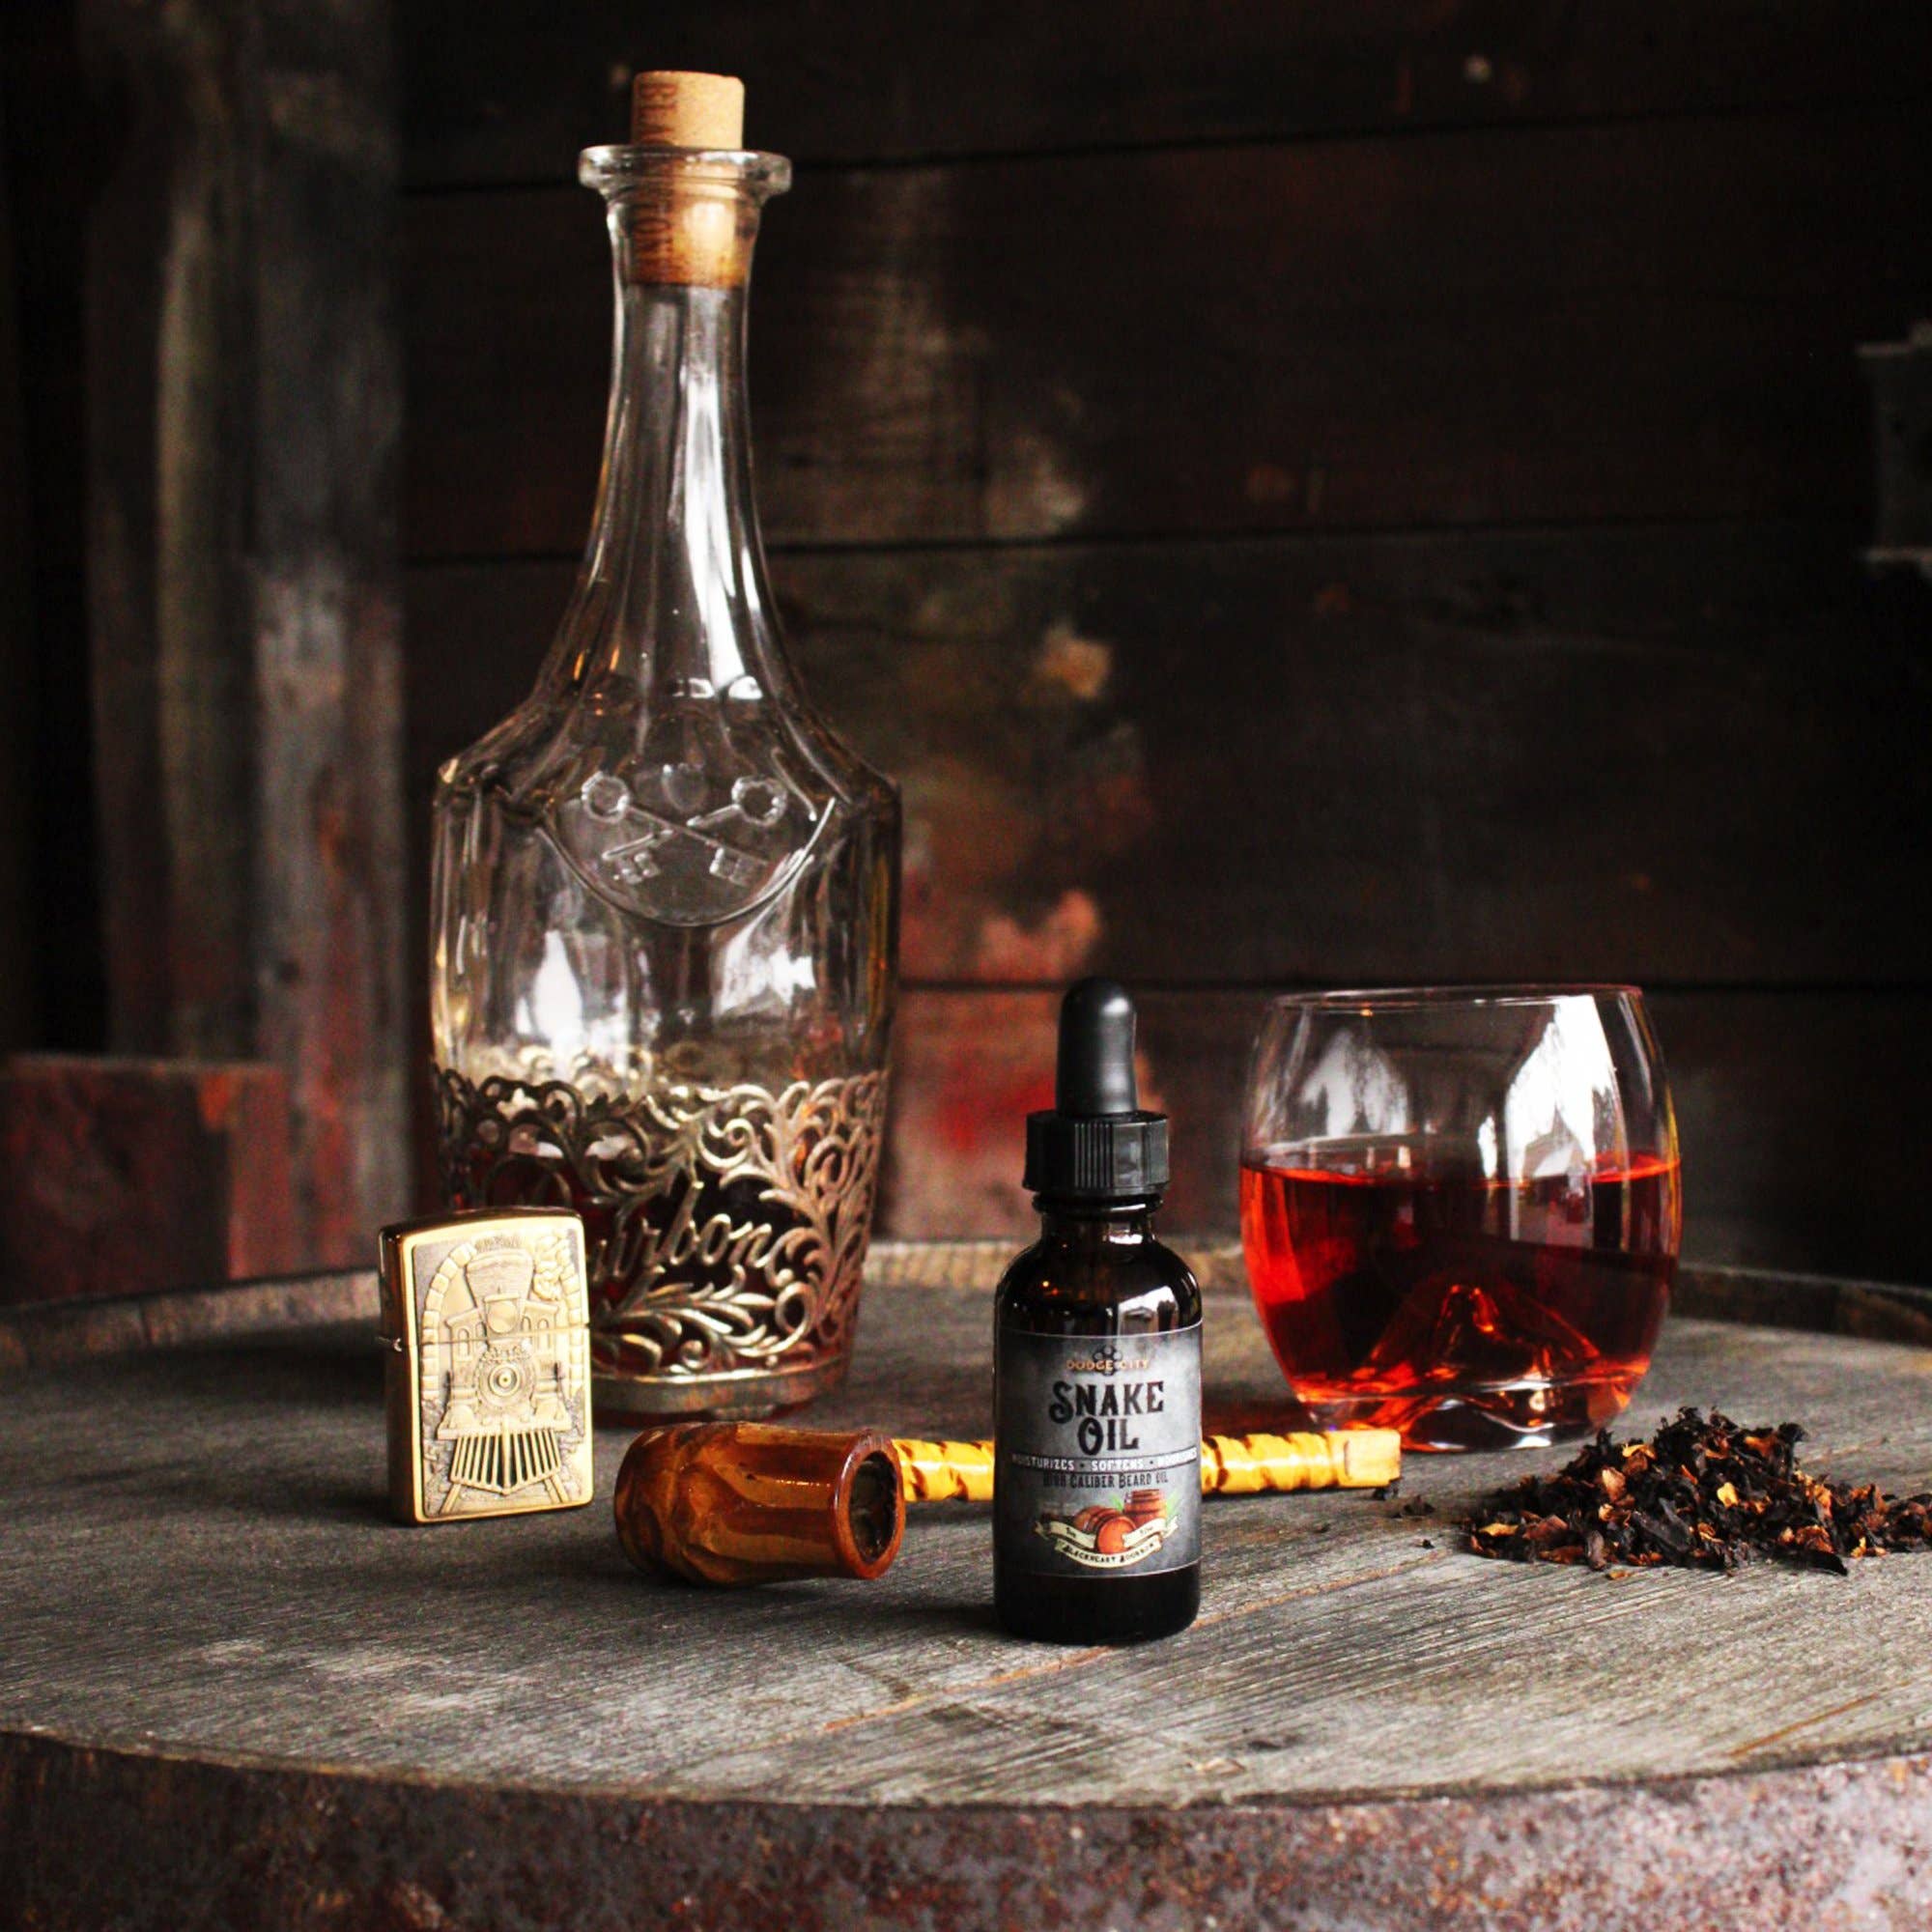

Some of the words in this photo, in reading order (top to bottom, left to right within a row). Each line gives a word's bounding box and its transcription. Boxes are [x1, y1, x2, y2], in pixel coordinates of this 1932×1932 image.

[591, 1180, 776, 1283] urbon
[1065, 1359, 1114, 1371] DODGE
[1120, 1359, 1150, 1369] CITY
[1048, 1380, 1165, 1424] SNAKE
[1077, 1417, 1139, 1456] OIL
[1070, 1473, 1115, 1489] CALIBER
[1119, 1471, 1151, 1489] BEARD
